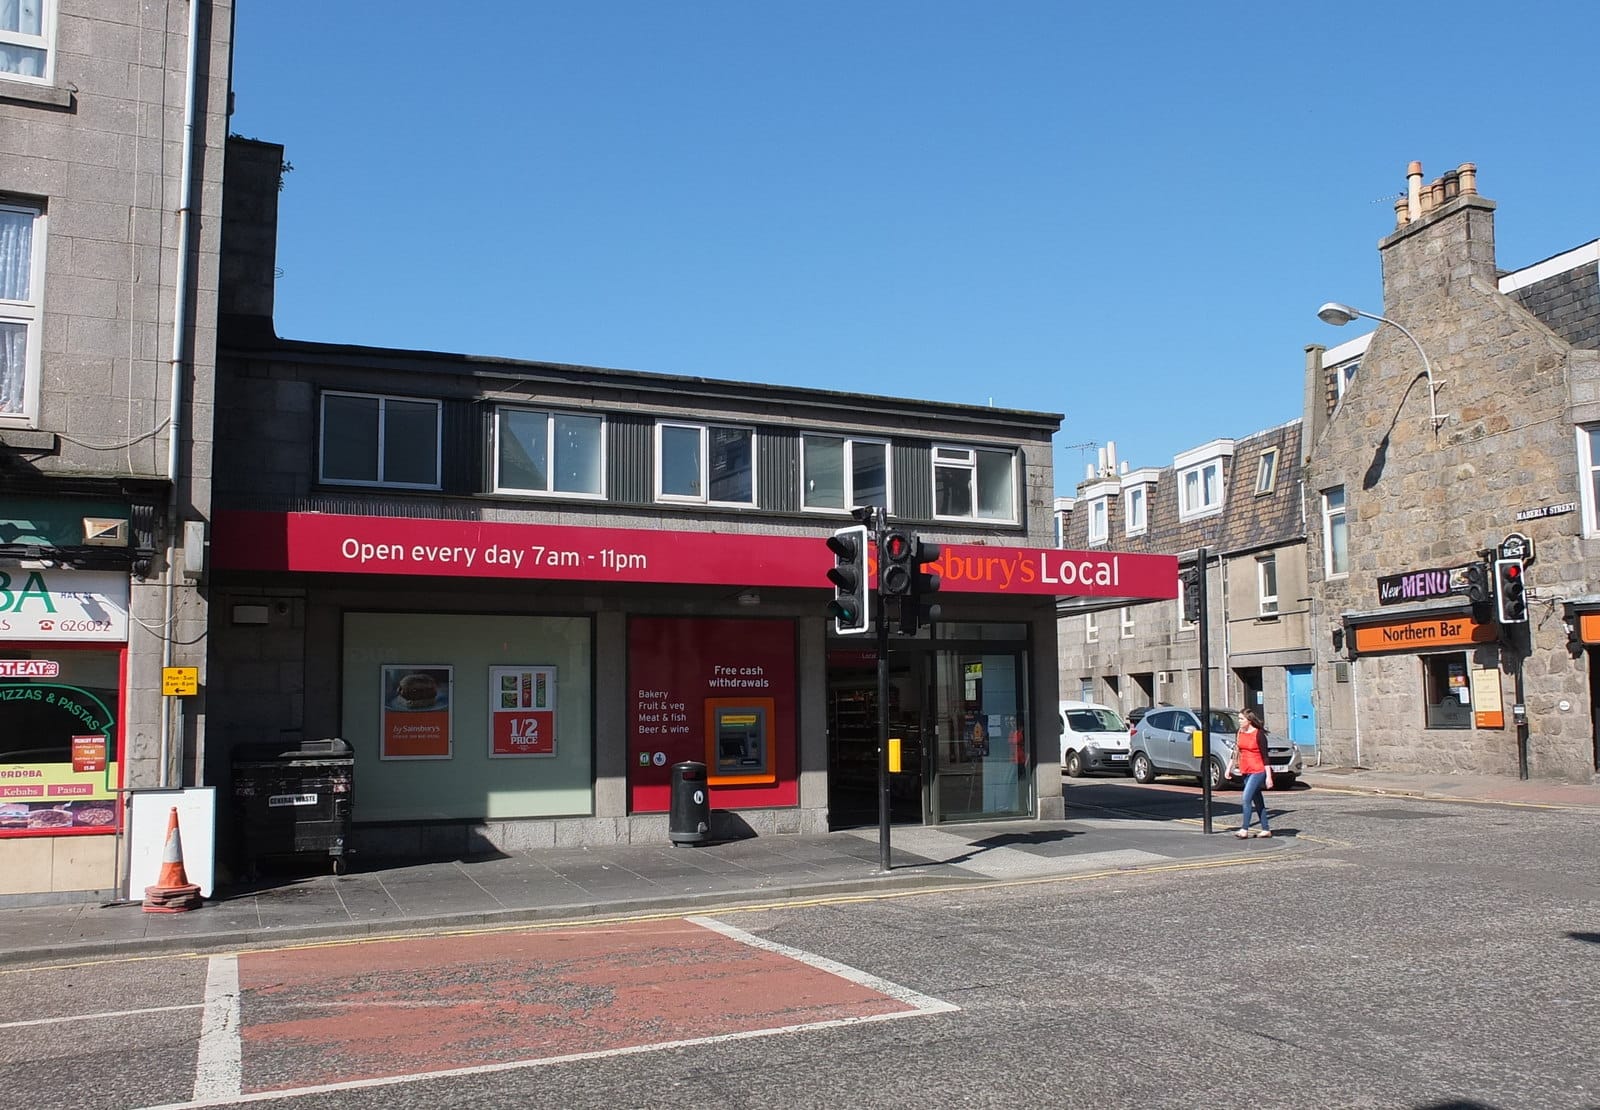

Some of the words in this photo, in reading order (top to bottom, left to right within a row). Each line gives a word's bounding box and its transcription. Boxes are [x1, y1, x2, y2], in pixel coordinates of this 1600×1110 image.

[1549, 502, 1575, 514] STREET
[342, 538, 404, 563] Open
[411, 546, 476, 567] every
[484, 544, 525, 569] day
[531, 546, 580, 567] 7am
[600, 549, 647, 572] 11pm
[1041, 553, 1119, 587] Local
[1381, 582, 1402, 599] New
[1402, 571, 1448, 598] MENU
[1382, 624, 1436, 643] Northern
[1440, 622, 1462, 637] Bar
[17, 662, 46, 675] EAT
[714, 665, 737, 675] Free
[740, 665, 764, 675] cash
[709, 678, 769, 688] withdrawals
[638, 690, 668, 699] Bakery
[46, 692, 58, 703] &
[58, 697, 100, 731] PASTAS
[638, 702, 658, 710] Fruit
[660, 702, 667, 710] &
[670, 703, 685, 711] veg
[638, 714, 659, 722] Meat
[662, 713, 669, 722] &
[671, 713, 686, 722] fish
[510, 718, 538, 737] 1/2
[638, 725, 659, 734] Beer
[661, 725, 668, 734] &
[670, 725, 689, 733] wine
[510, 735, 538, 745] PRICE
[3, 787, 38, 796] Kebabs
[57, 786, 87, 795] Pastas
